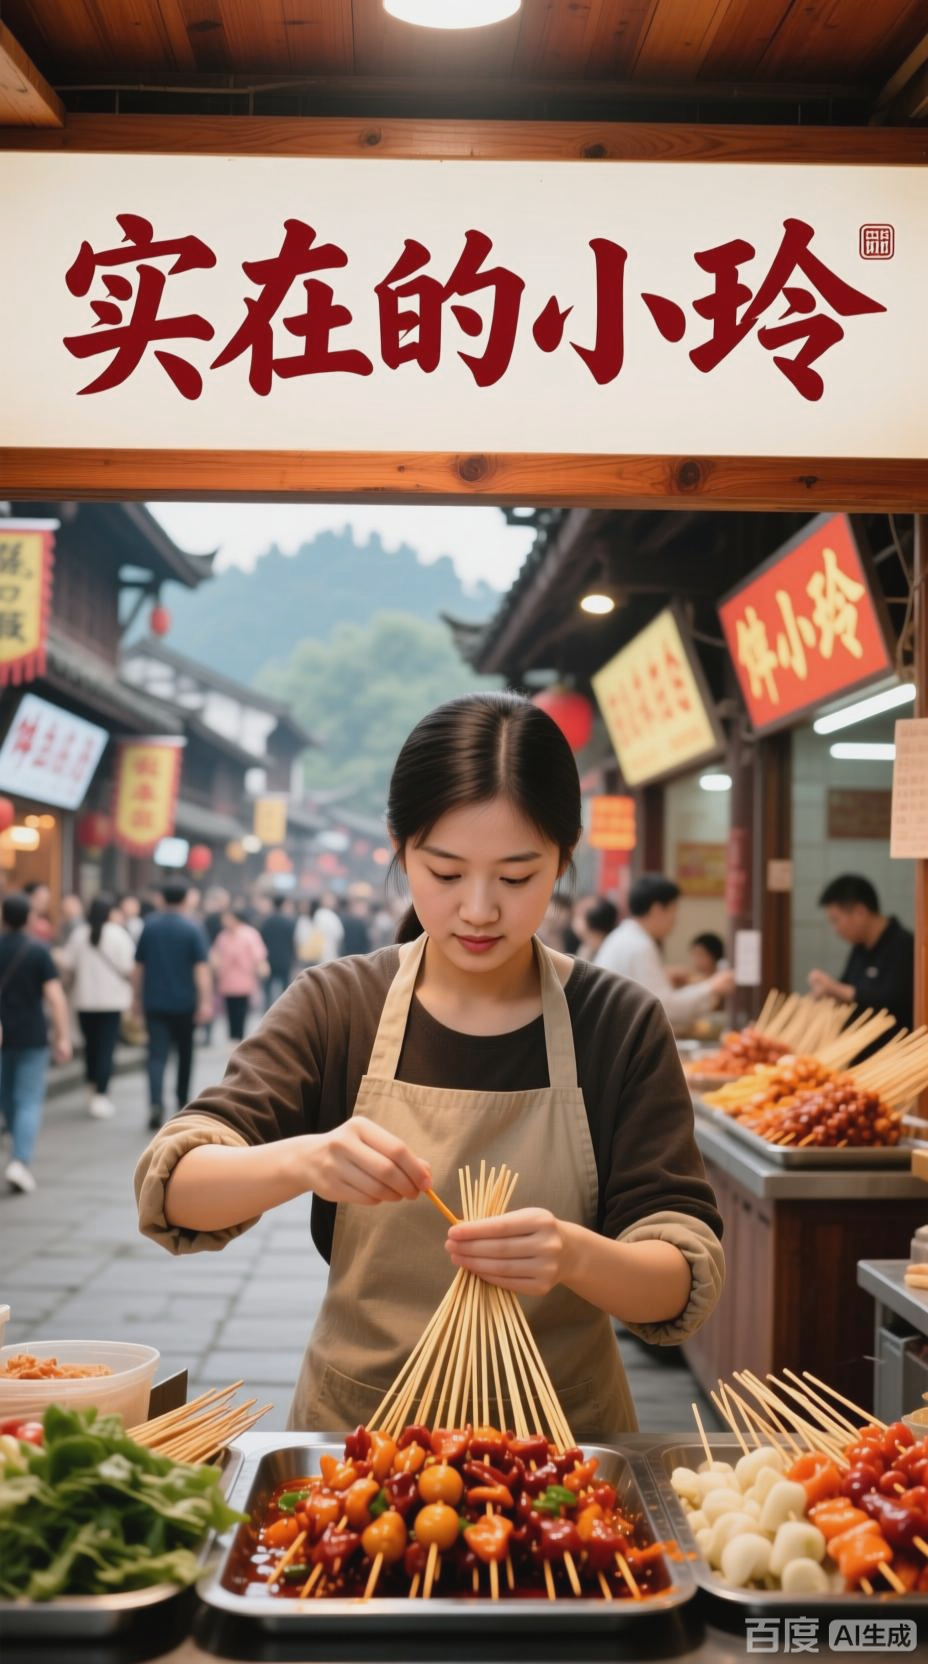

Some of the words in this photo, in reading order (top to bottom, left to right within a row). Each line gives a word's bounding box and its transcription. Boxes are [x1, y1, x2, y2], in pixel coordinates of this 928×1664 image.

[63, 213, 887, 401] 实在的小玲
